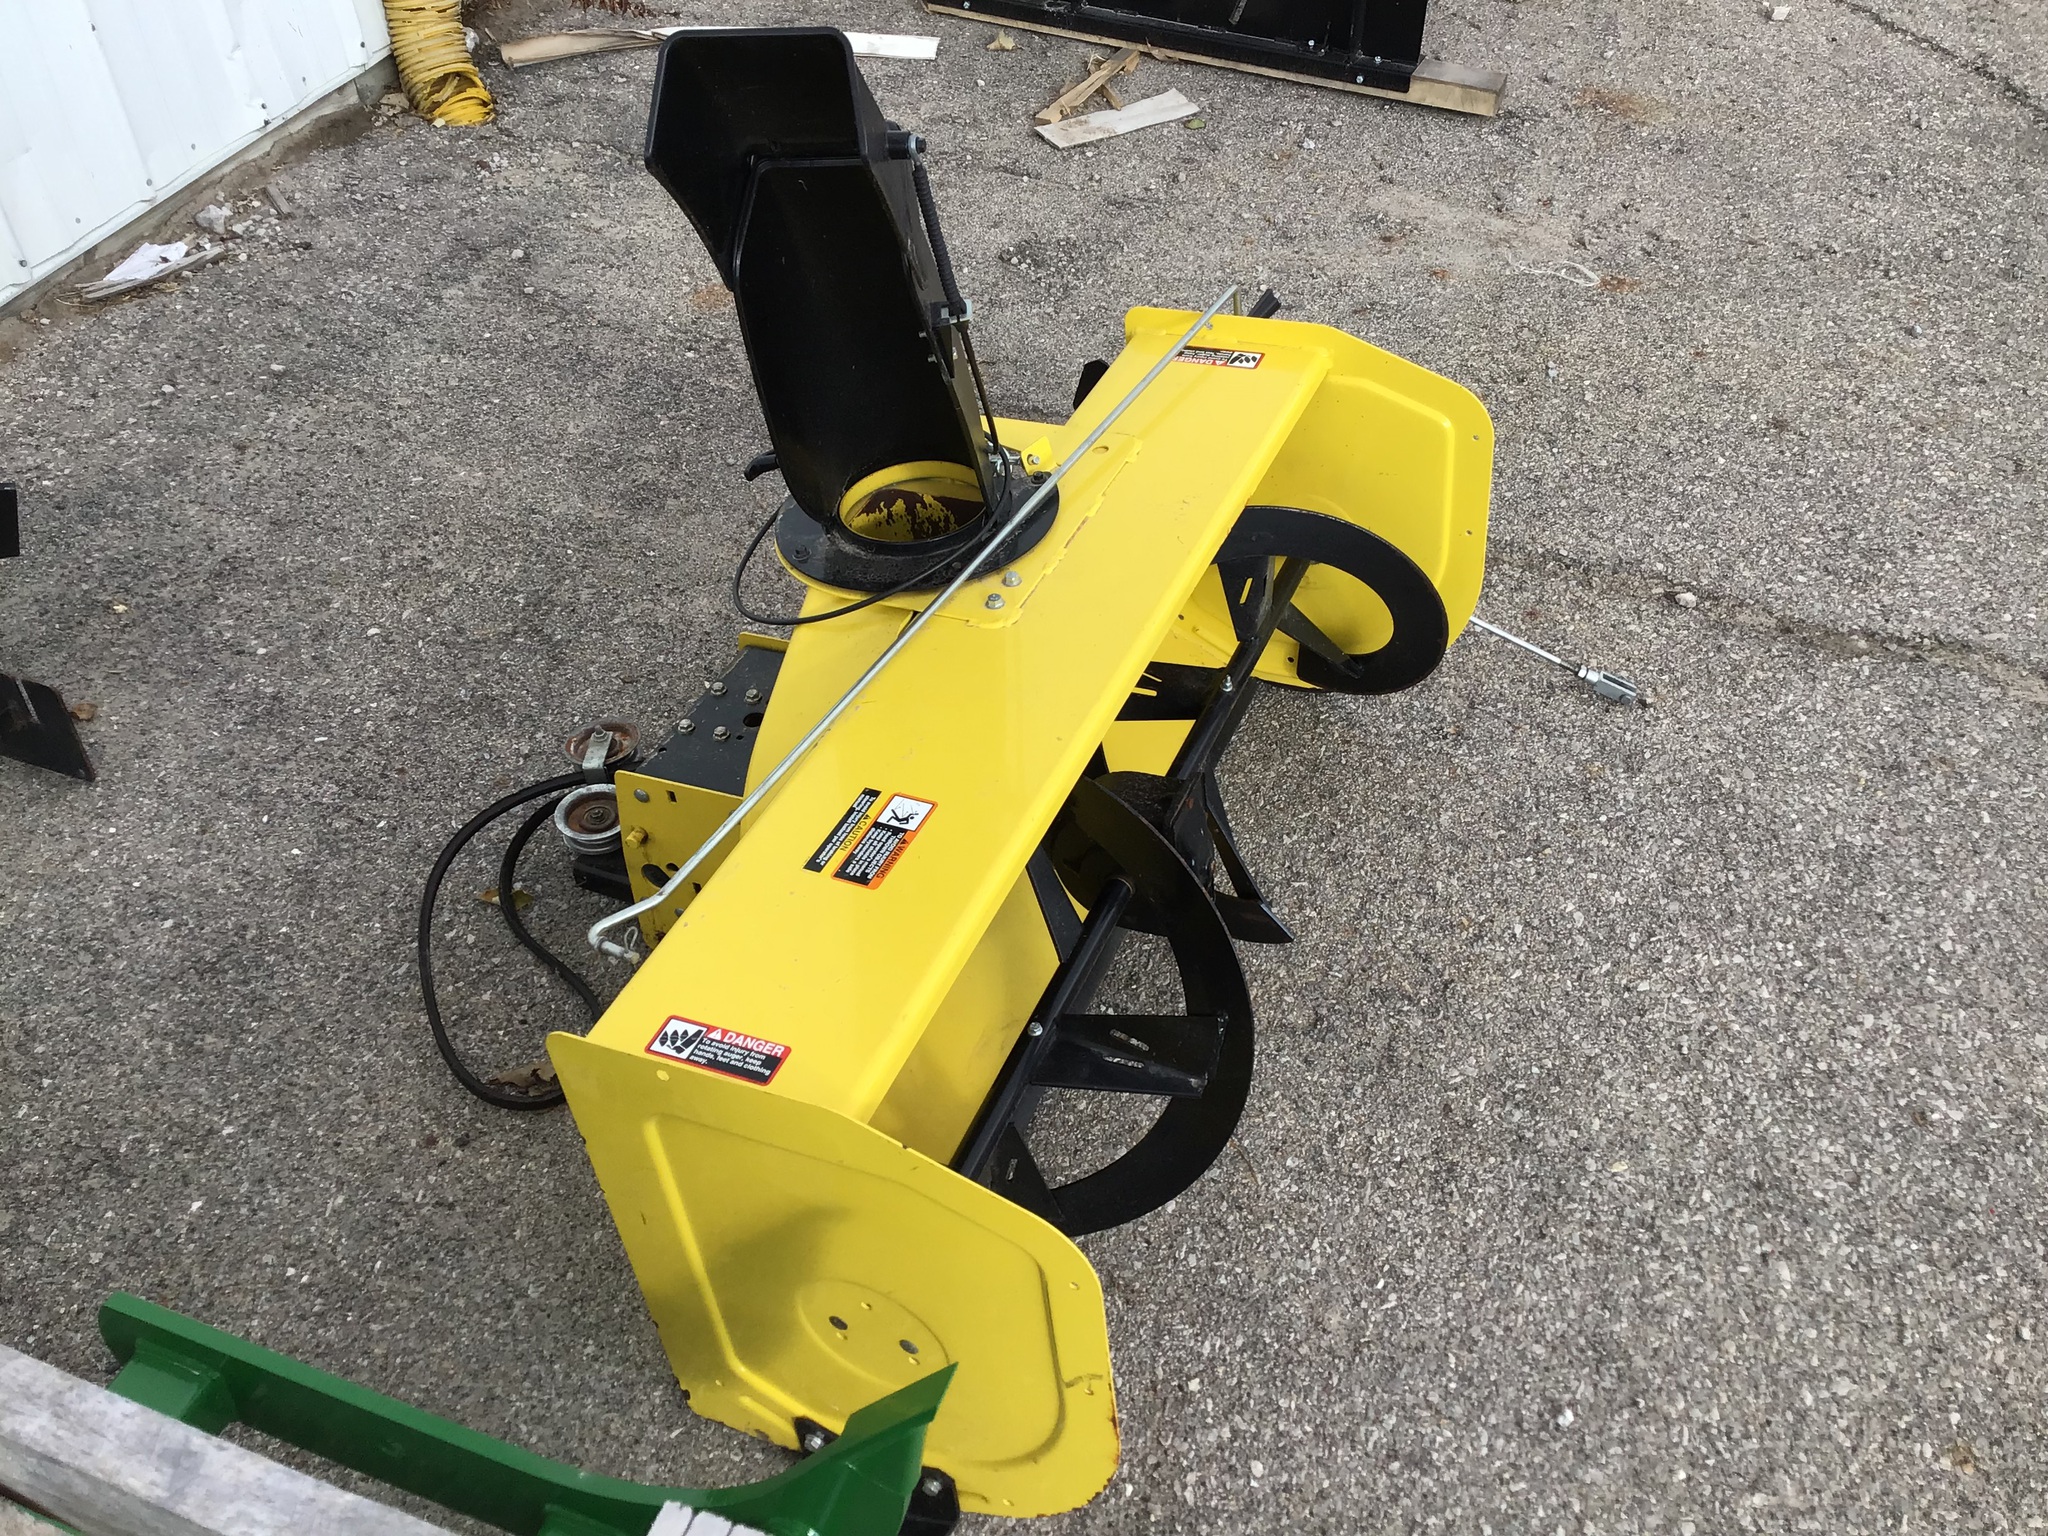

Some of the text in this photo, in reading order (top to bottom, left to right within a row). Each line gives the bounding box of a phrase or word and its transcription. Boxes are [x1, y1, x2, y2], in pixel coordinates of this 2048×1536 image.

[840, 821, 867, 851] CAUTION
[876, 846, 905, 878] WARNING
[696, 1044, 724, 1056] rotating
[745, 1057, 762, 1066] keep
[702, 1037, 766, 1060] To avoid injury from
[723, 1032, 785, 1057] DANGER
[689, 1055, 708, 1065] away.
[693, 1049, 715, 1060] hands,
[716, 1055, 730, 1063] feet
[743, 1063, 771, 1076] clothing
